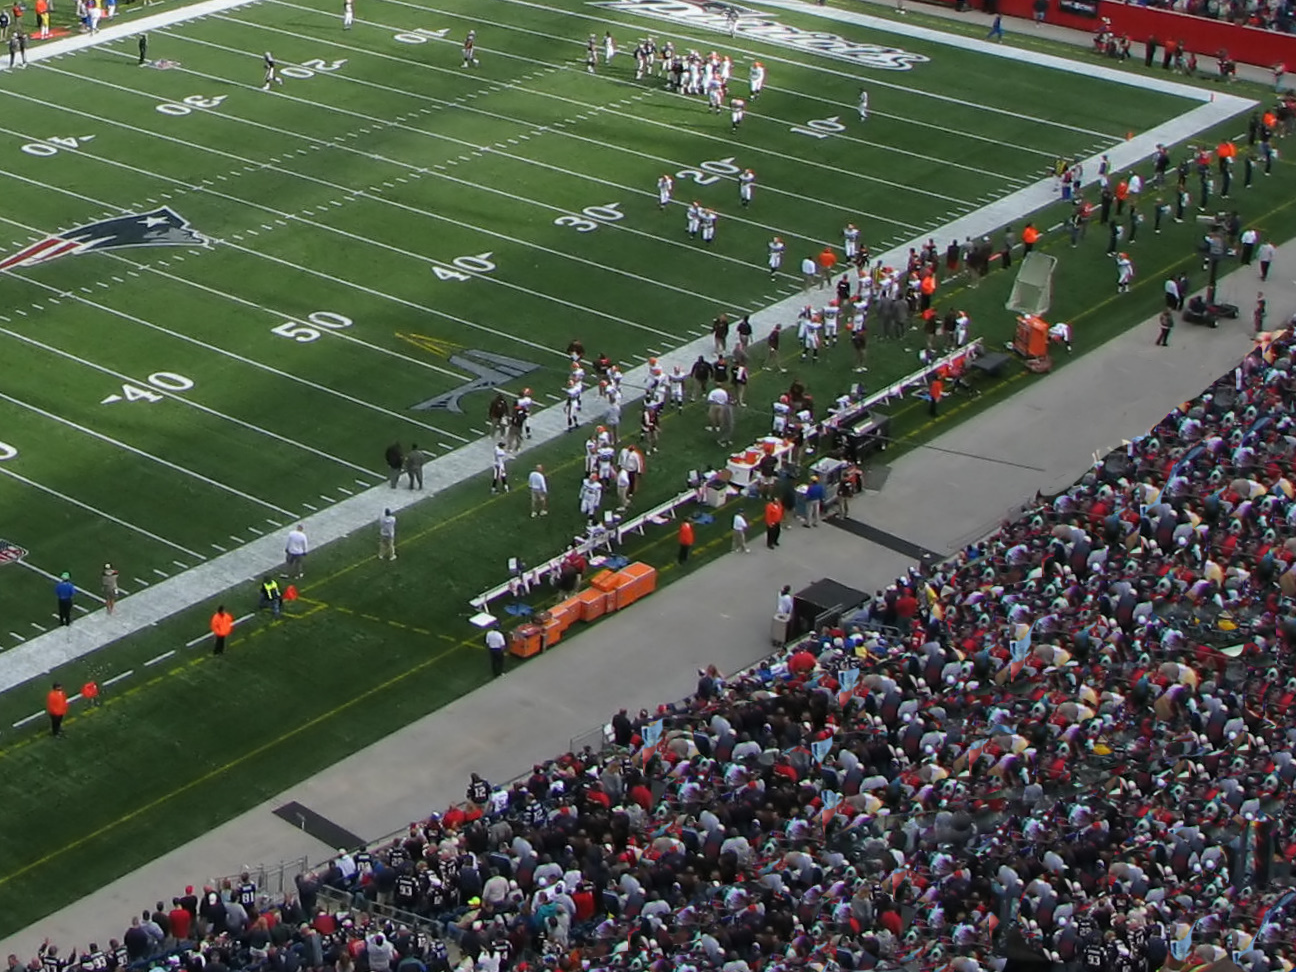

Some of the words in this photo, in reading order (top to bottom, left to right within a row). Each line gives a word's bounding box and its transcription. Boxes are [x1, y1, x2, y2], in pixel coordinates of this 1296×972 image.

[280, 58, 344, 79] 20
[154, 94, 226, 117] 30
[790, 117, 847, 140] 10
[21, 135, 92, 158] 40
[675, 158, 740, 186] 20
[554, 204, 625, 234] 30
[430, 253, 497, 283] 40
[271, 310, 354, 343] 50
[115, 371, 195, 404] 40
[474, 786, 486, 798] 12
[242, 891, 254, 904] 81
